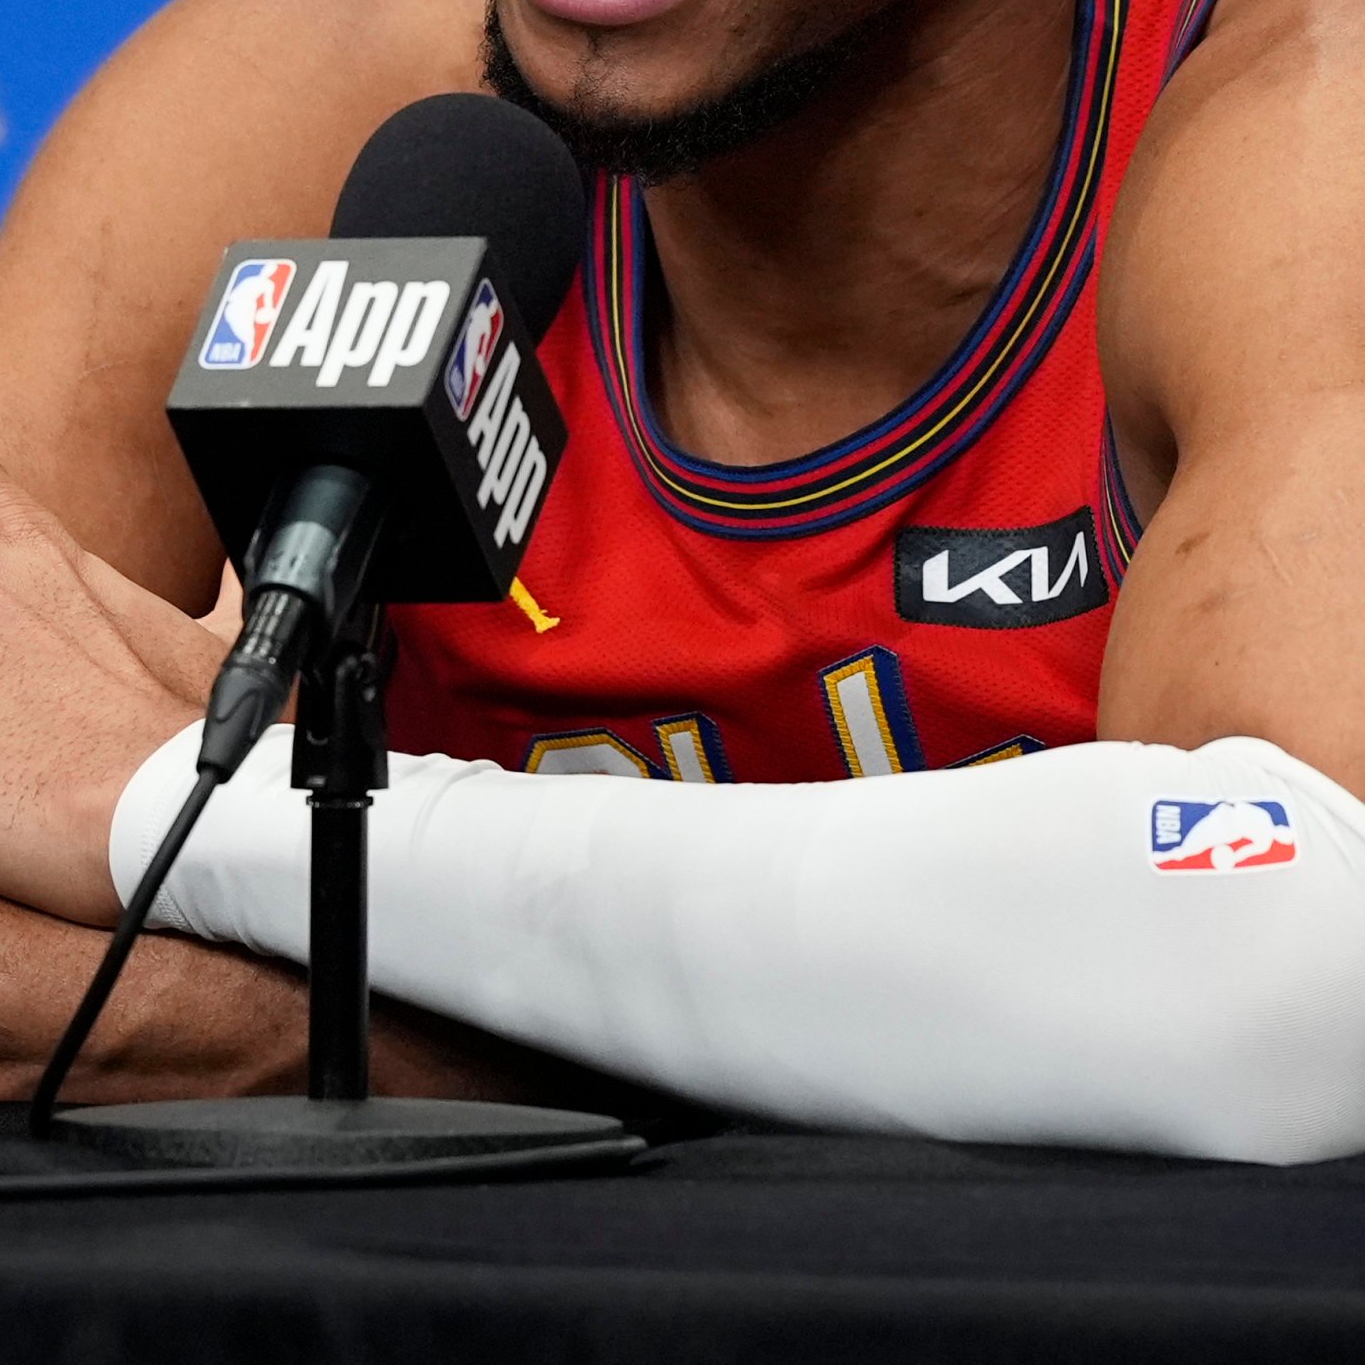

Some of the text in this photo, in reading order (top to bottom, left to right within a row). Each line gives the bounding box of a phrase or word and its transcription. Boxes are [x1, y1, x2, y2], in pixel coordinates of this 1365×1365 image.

[269, 260, 451, 388] App
[466, 341, 549, 549] App
[922, 530, 1089, 605] KIA
